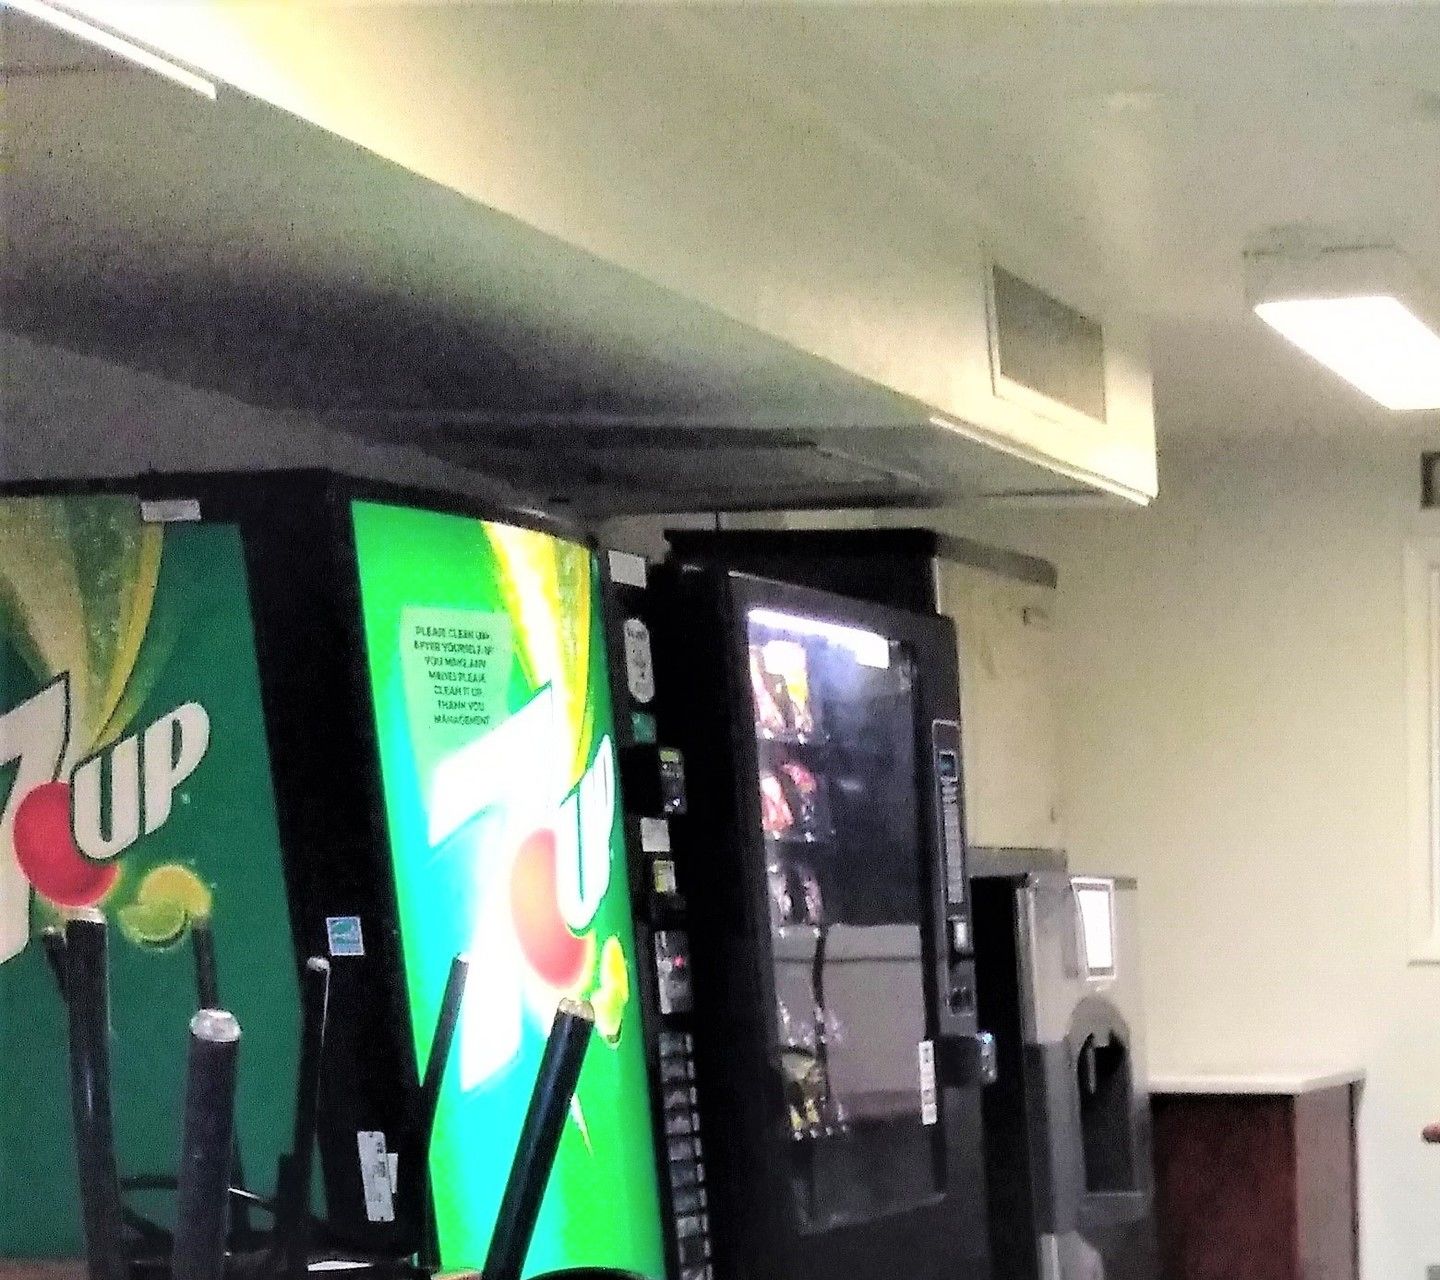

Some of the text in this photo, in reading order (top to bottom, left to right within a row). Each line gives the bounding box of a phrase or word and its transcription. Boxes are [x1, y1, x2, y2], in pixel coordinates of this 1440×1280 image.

[448, 628, 474, 639] CLEAN
[424, 656, 443, 666] YOU
[434, 685, 462, 695] CLEAN
[438, 699, 484, 711] THANK YOU
[434, 714, 490, 725] MANAGEMENT
[70, 701, 211, 859] UP
[553, 733, 616, 932] UP
